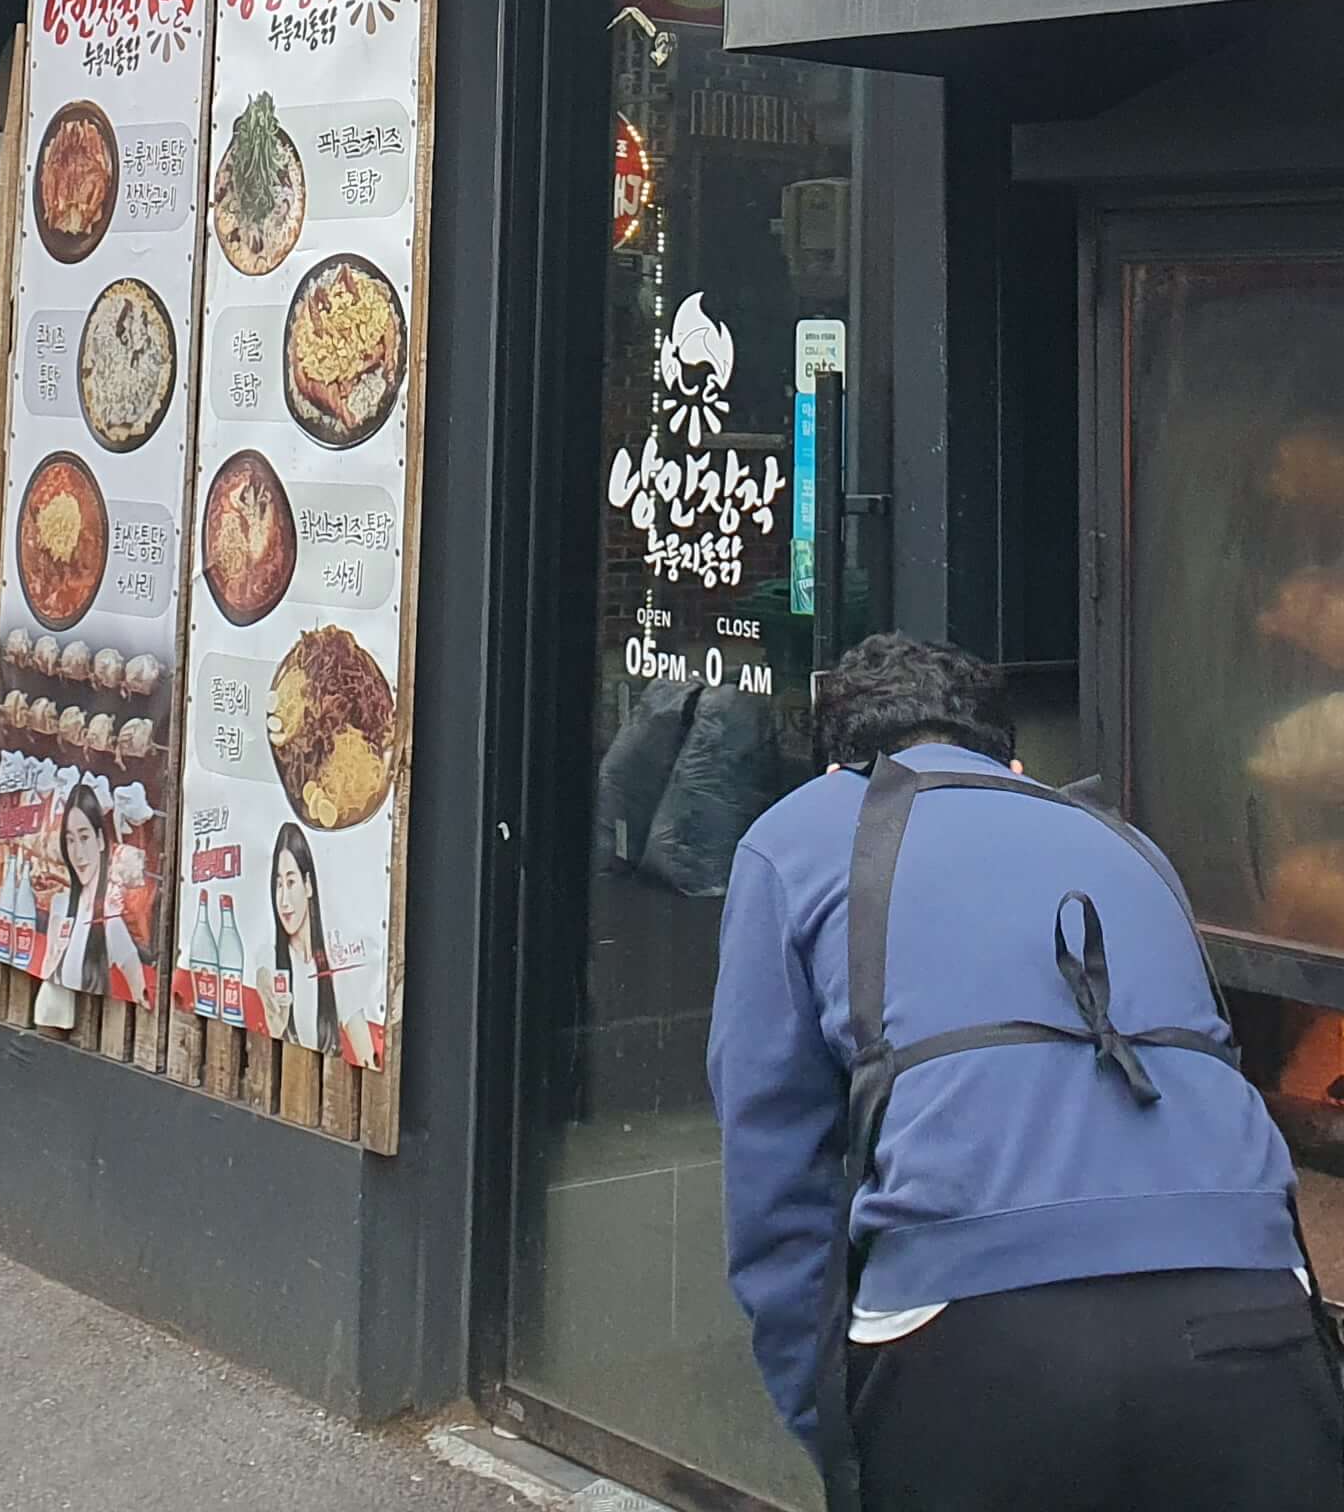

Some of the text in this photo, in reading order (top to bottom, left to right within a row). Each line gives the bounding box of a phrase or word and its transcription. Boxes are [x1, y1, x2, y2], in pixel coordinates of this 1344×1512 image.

[268, 6, 338, 52] 누룽지통닭
[83, 35, 142, 77] 누룽지통닭
[122, 139, 187, 177] 누룽지통닭
[125, 181, 176, 219] 장작구이
[340, 169, 381, 204] 통닭
[232, 329, 262, 362] 마늘
[38, 363, 60, 400] 통닭
[229, 373, 261, 407] 통닭
[113, 519, 167, 564] 화산통닭
[299, 509, 394, 550] 화산치즈통닭
[323, 559, 364, 596] +사리
[643, 531, 744, 588] 누룽지통닭
[117, 573, 153, 601] +사리
[636, 607, 761, 639] OPEN CLOSE
[738, 663, 773, 696] AM
[214, 726, 244, 762] 무침
